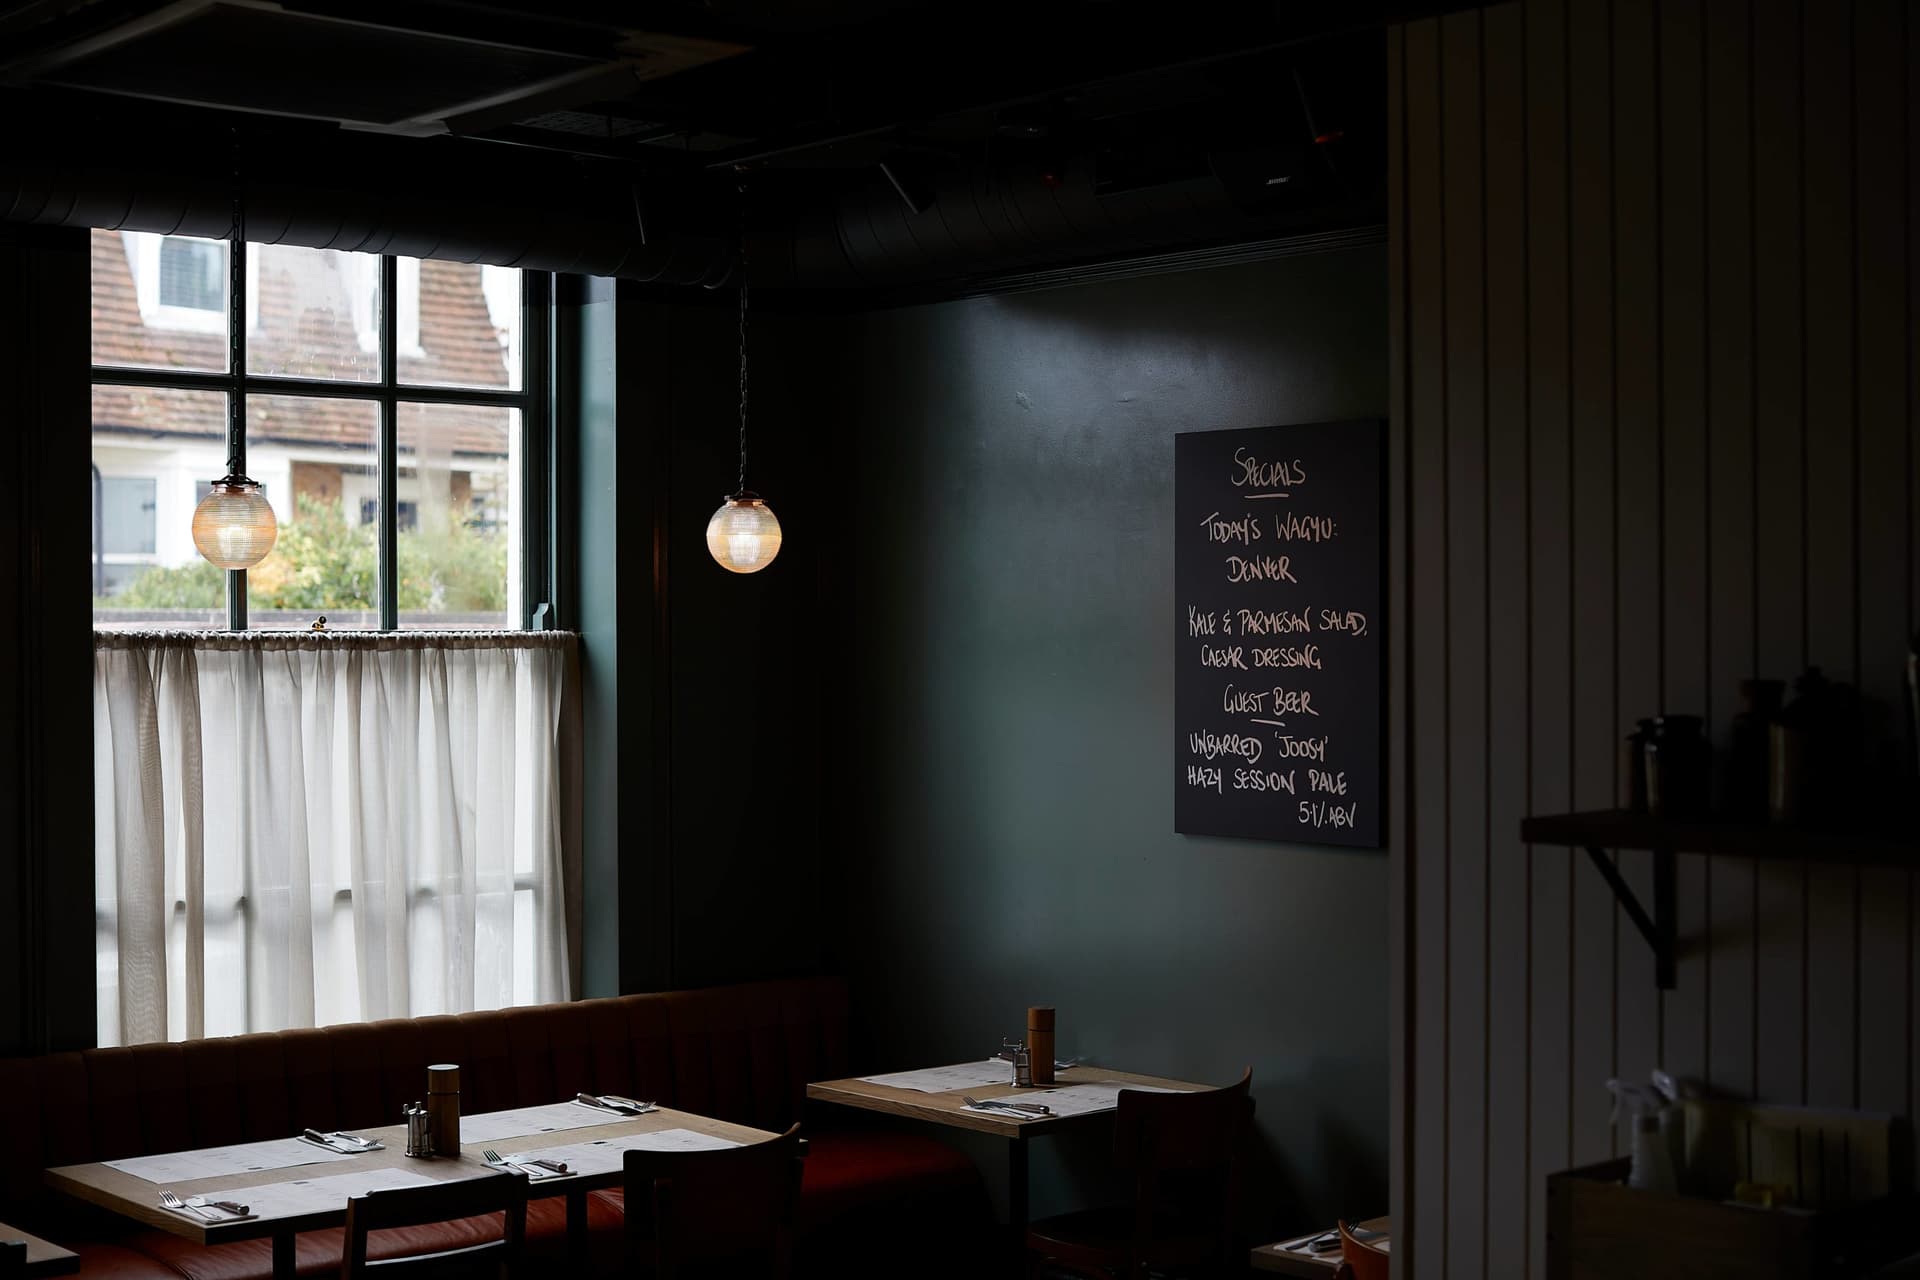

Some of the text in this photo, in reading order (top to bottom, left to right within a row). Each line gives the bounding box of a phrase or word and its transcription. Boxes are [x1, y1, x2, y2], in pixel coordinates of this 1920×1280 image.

[1231, 447, 1306, 487] SPECIALS
[1200, 512, 1338, 545] TODAY'S WAGYU:
[1226, 555, 1298, 583] DENVER
[1188, 604, 1368, 638] KALE & PARMESAN SALAD,
[1201, 644, 1322, 670] CAESAR DRESSING
[1224, 684, 1320, 716] GUEST BEER
[1189, 728, 1263, 764] UNBARRED
[1188, 765, 1348, 795] HAZY SESSION PALE
